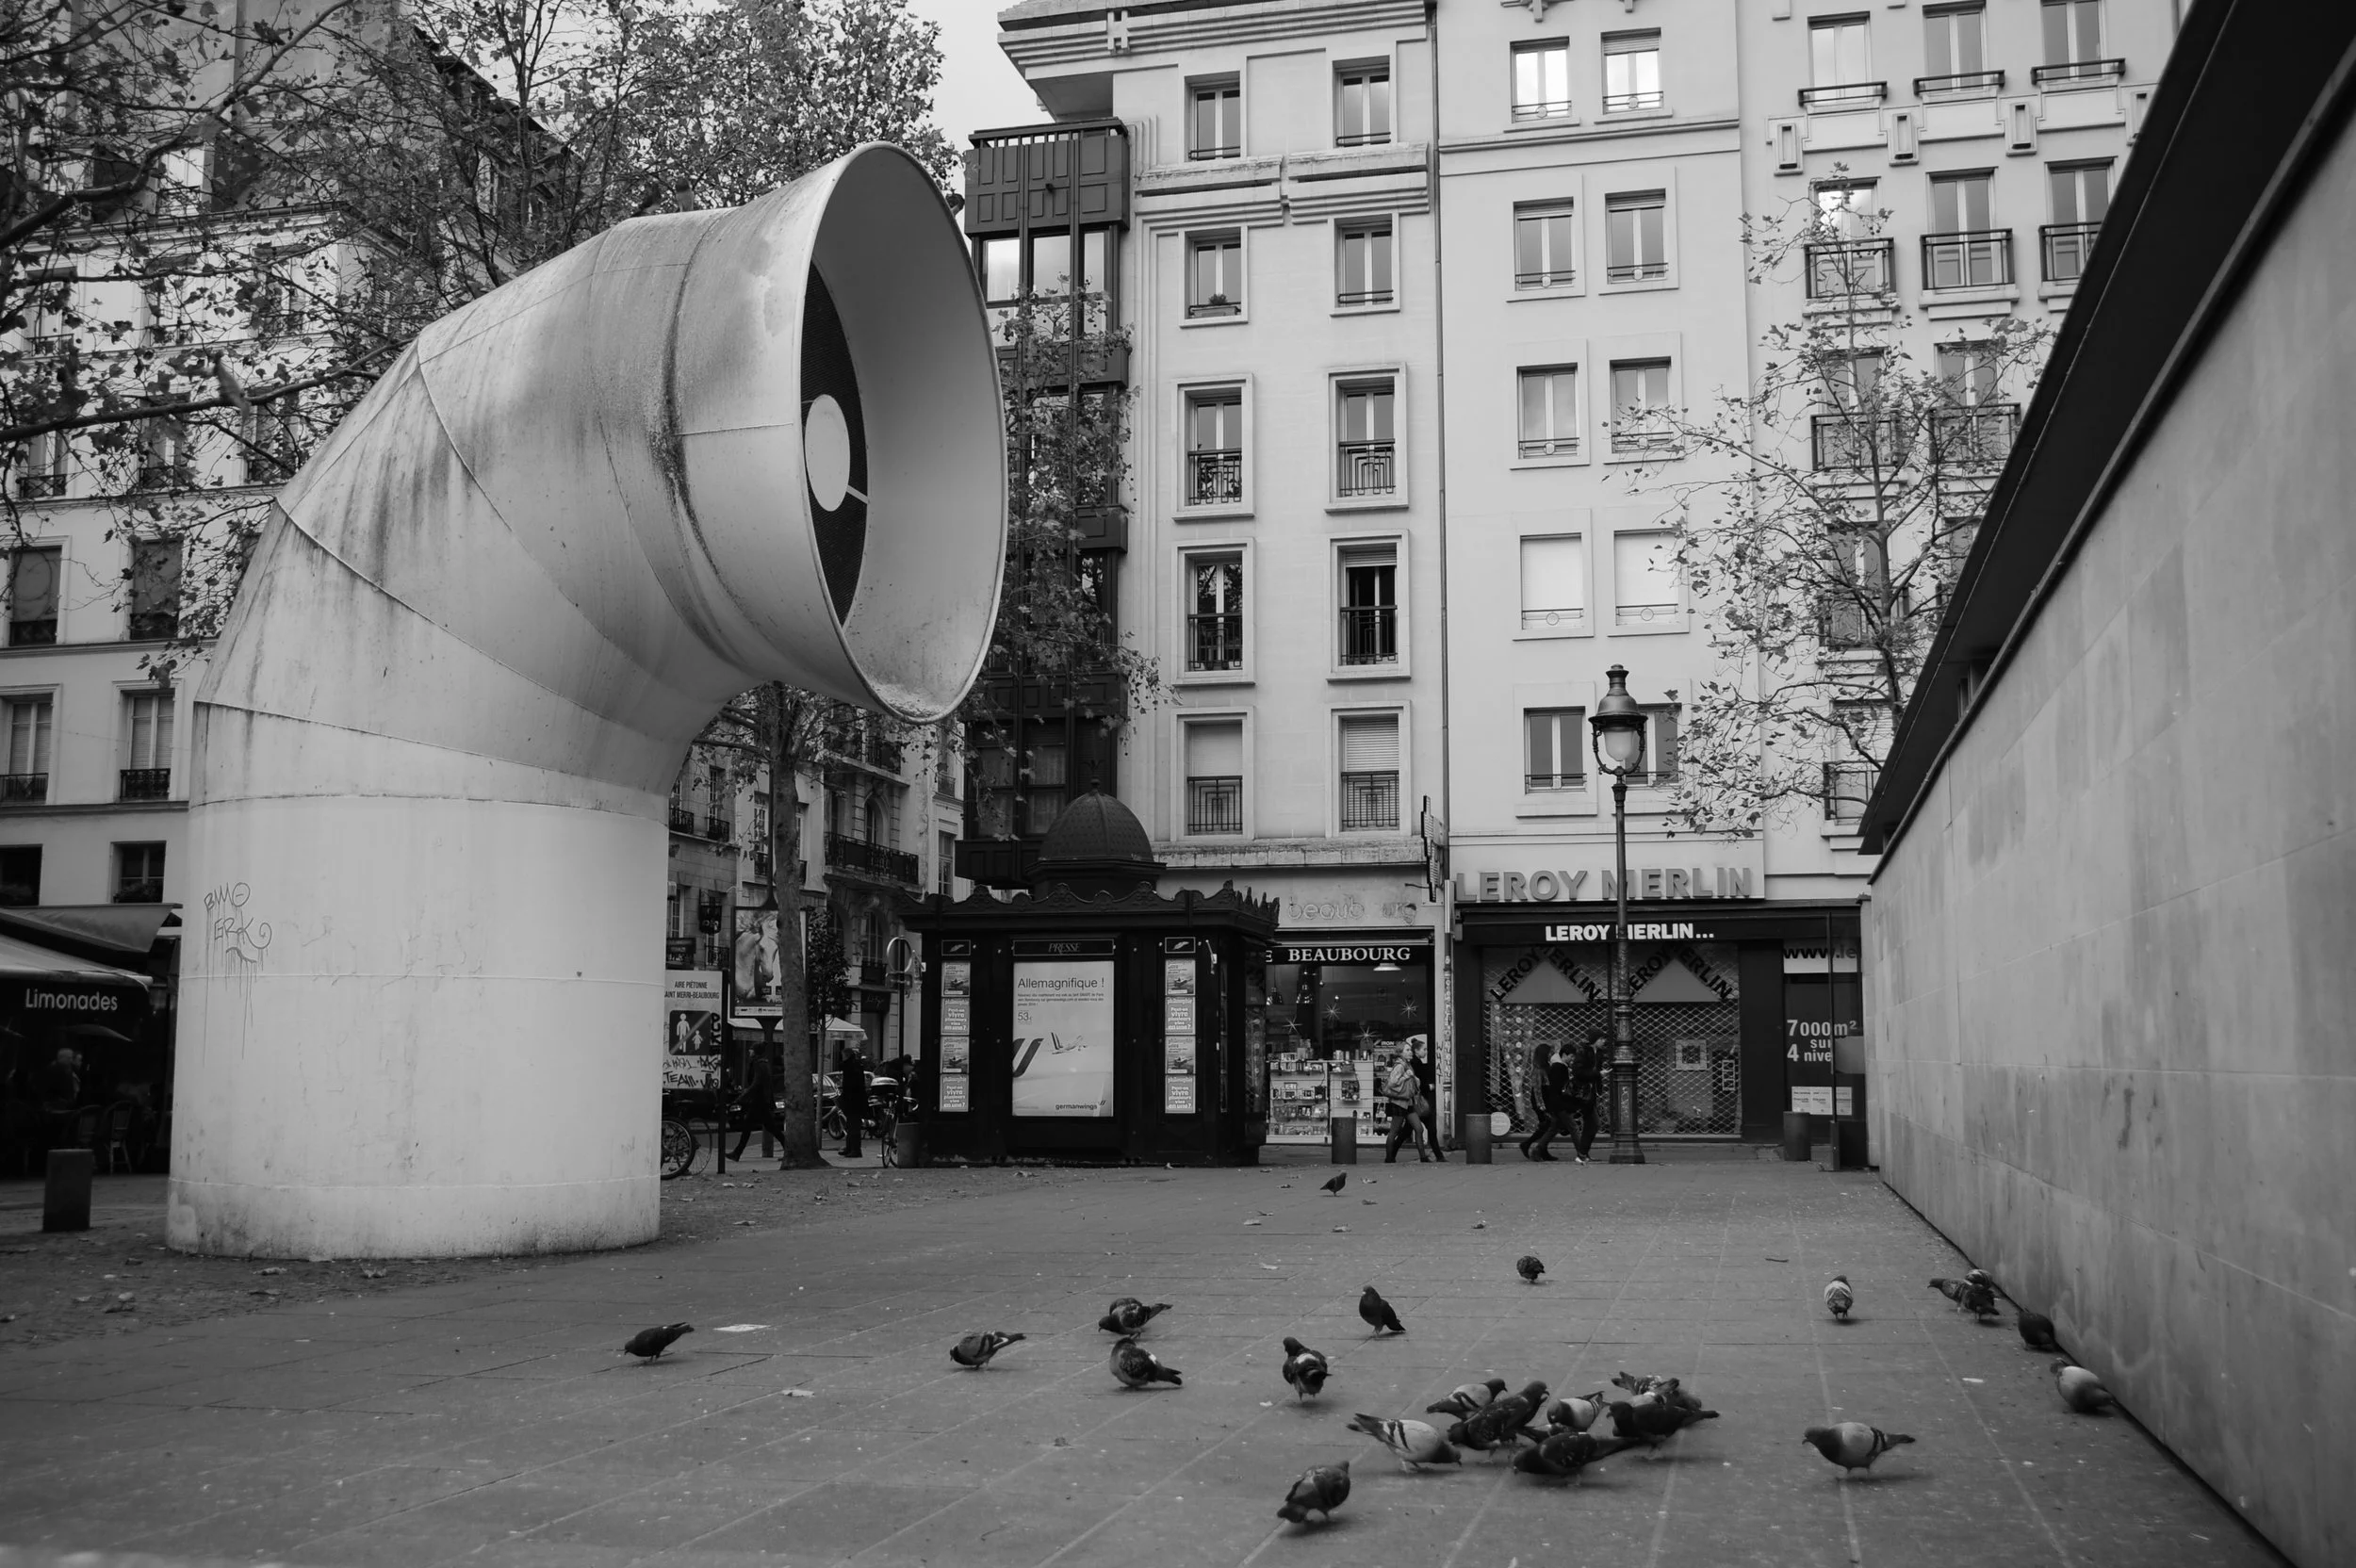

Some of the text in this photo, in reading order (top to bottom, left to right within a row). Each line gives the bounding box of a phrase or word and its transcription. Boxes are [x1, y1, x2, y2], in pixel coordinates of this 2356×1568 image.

[1456, 870, 1588, 901] LEROY
[1546, 924, 1610, 941] LEROY
[1048, 942, 1081, 953] PRESSE
[1287, 947, 1411, 962] BEAUBOURG
[1490, 945, 1601, 1001] LEROY ERLIN
[1628, 944, 1733, 999] EROY ERLIN
[686, 980, 708, 989] PIÉTONNE
[1018, 977, 1098, 990] Allemagnifique
[25, 988, 118, 1011] Limonades
[664, 990, 676, 999] AINT
[1787, 1043, 1799, 1062] 4
